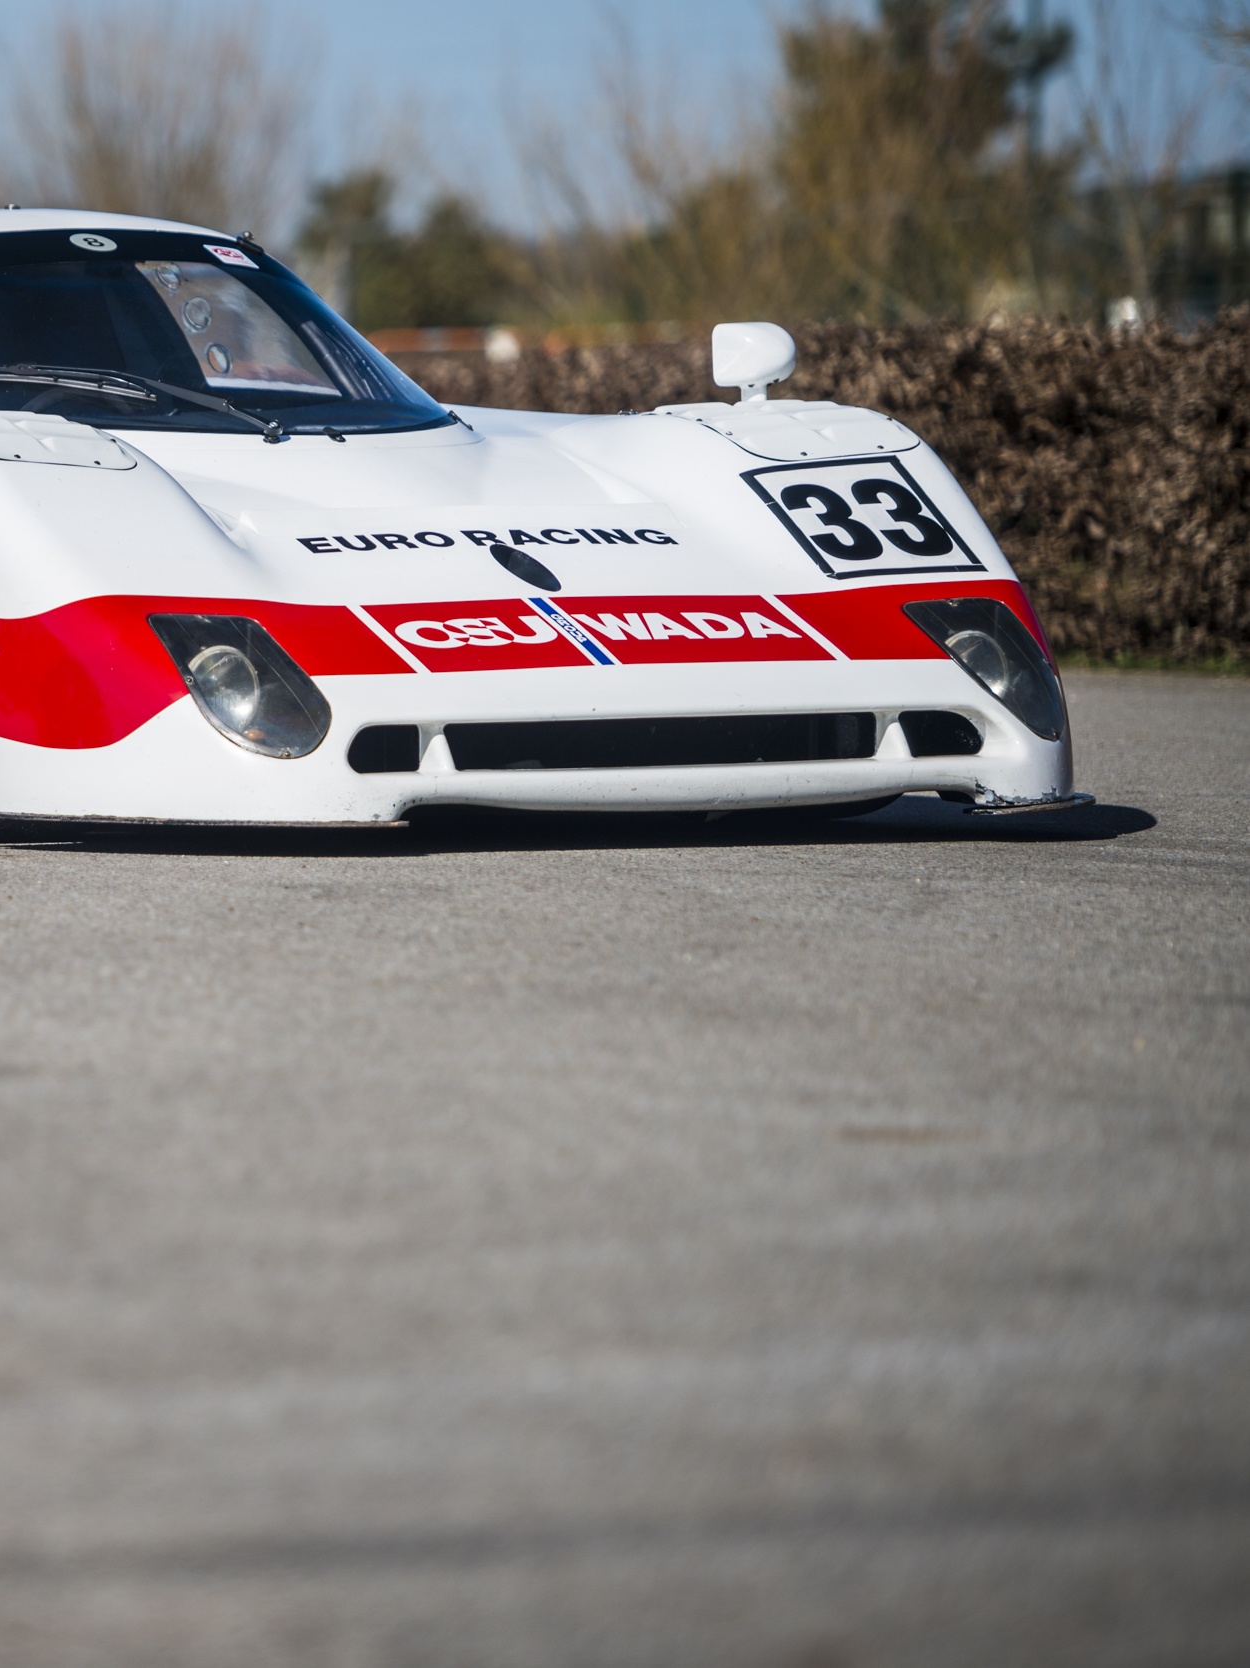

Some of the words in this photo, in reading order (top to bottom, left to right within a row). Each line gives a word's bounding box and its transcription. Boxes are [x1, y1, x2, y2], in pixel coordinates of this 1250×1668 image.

[780, 478, 954, 561] 33
[296, 531, 455, 554] EURO
[460, 528, 679, 546] RACING
[395, 615, 558, 649] OSU
[572, 612, 802, 640] WADA
[550, 613, 588, 643] GROUP
